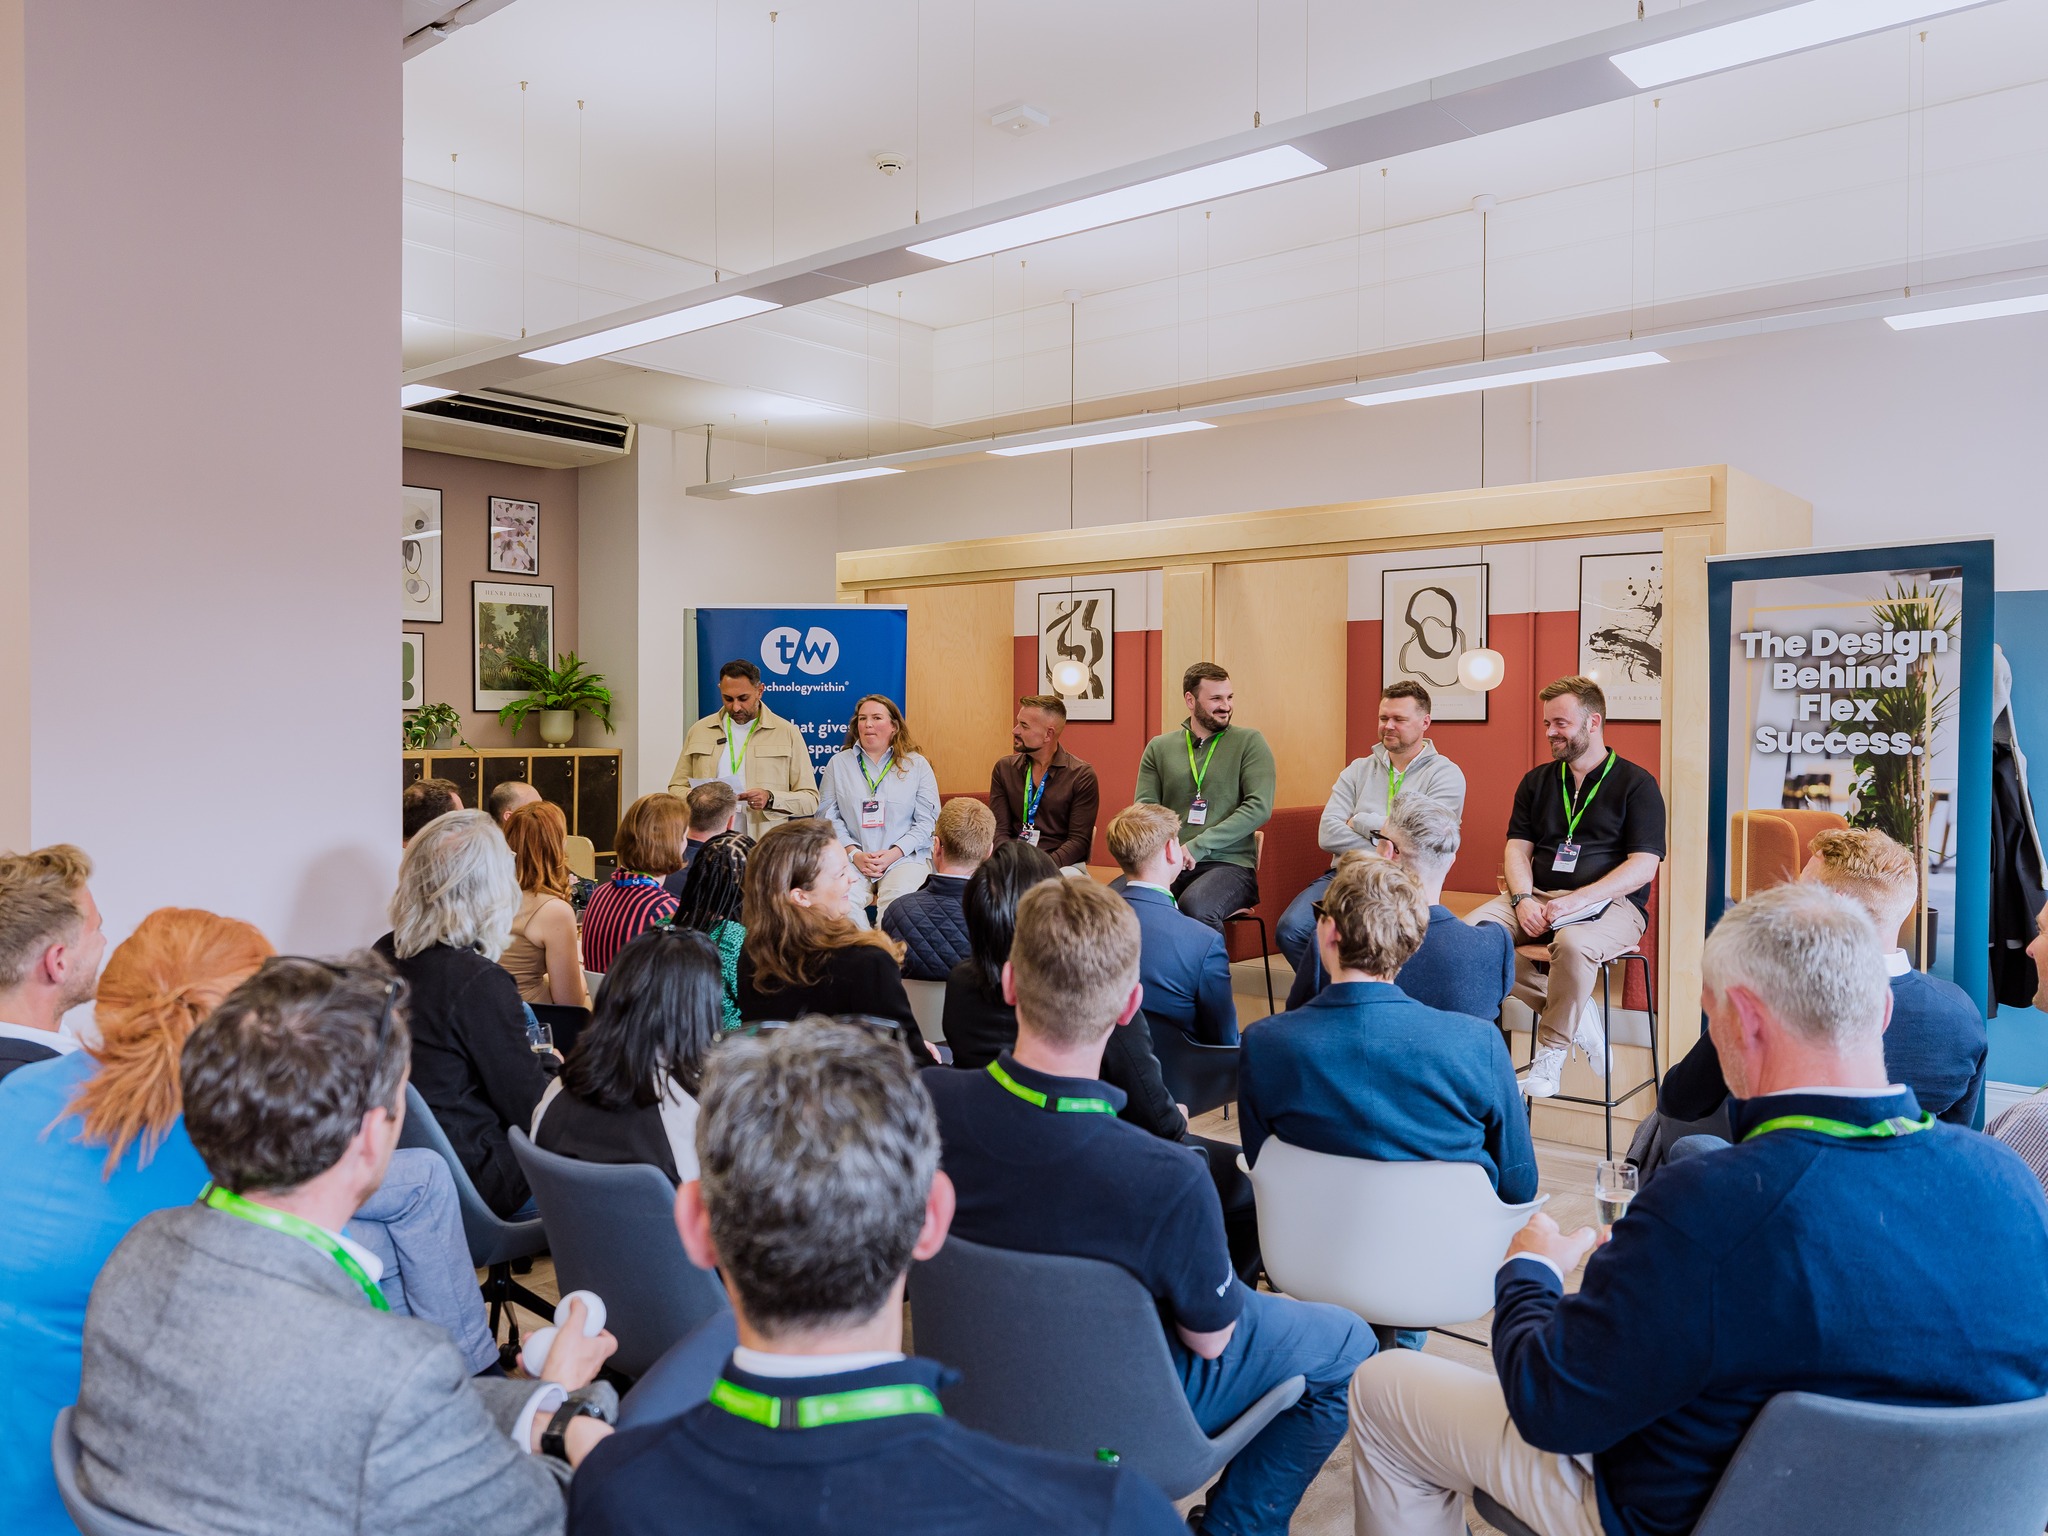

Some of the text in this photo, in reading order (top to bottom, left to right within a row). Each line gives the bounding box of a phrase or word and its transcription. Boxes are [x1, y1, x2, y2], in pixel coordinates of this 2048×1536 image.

[1740, 621, 1948, 664] The Design
[1773, 656, 1908, 690] Behind
[1799, 692, 1879, 722] Flex
[1755, 725, 1925, 756] Success.
